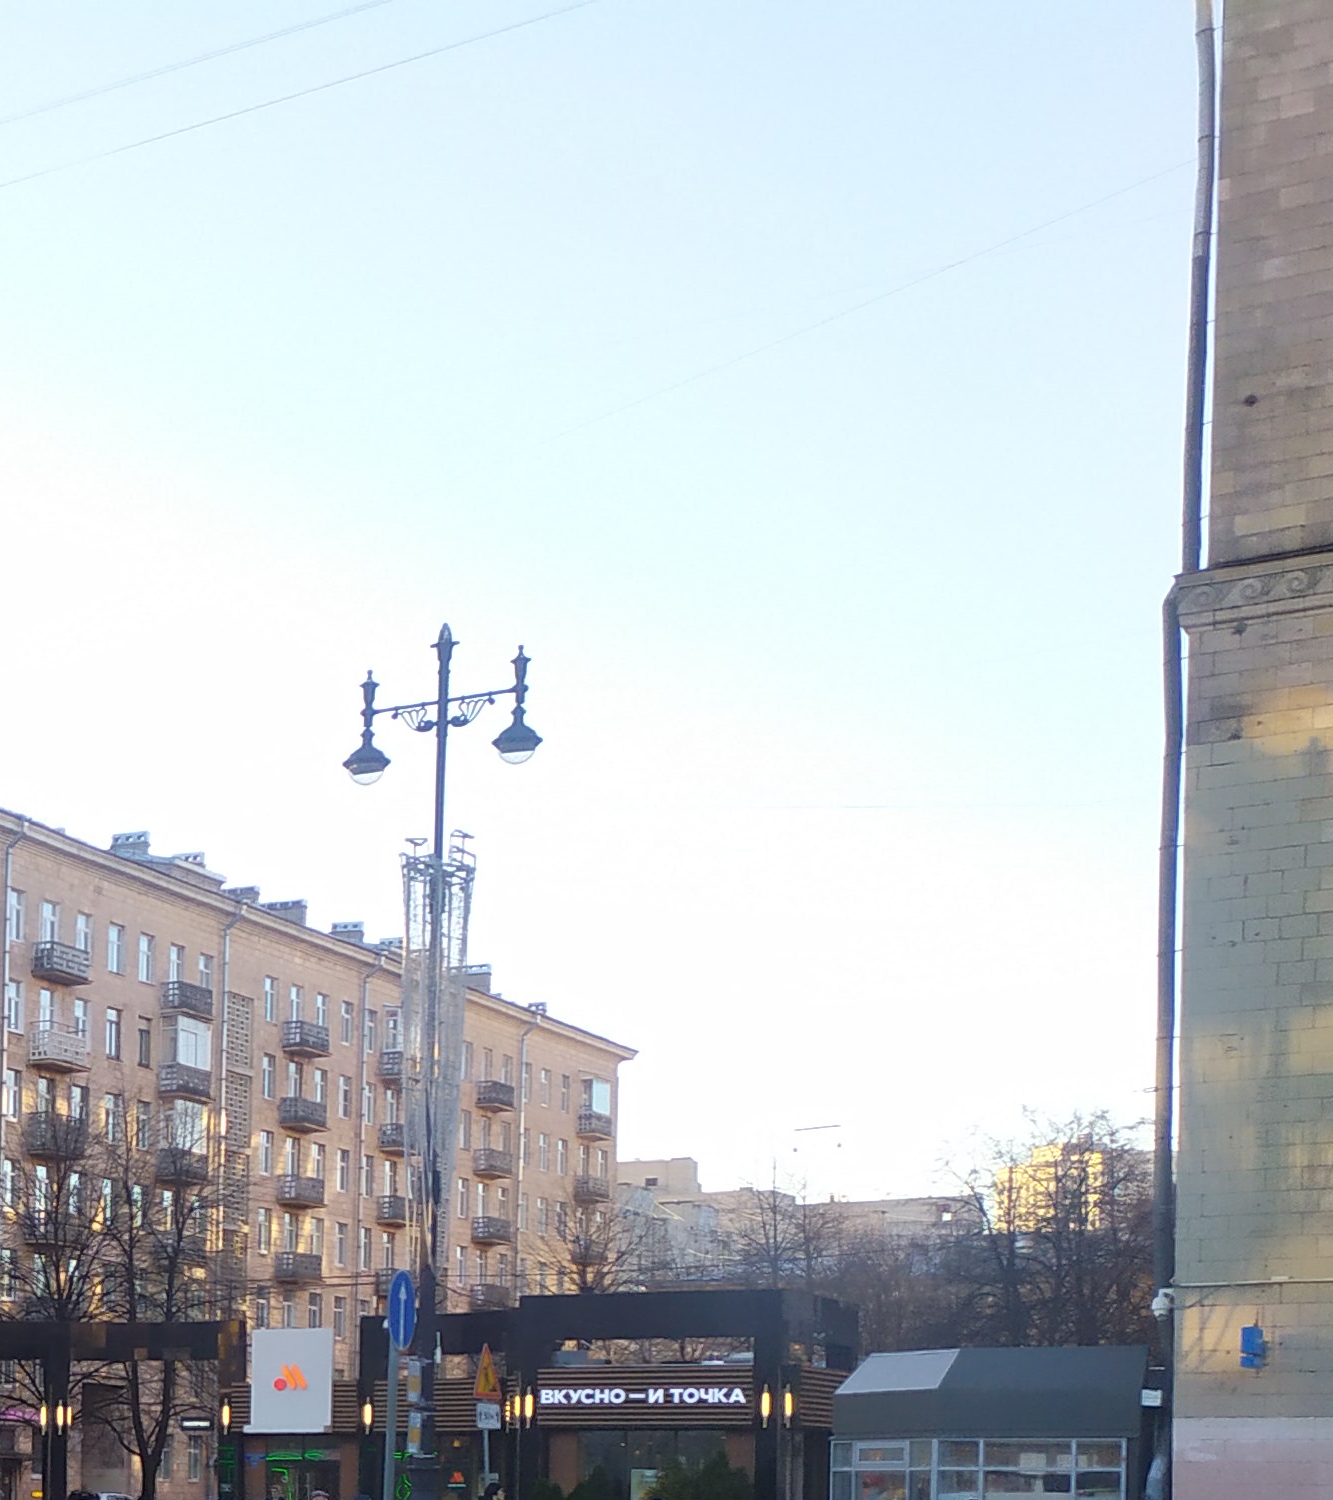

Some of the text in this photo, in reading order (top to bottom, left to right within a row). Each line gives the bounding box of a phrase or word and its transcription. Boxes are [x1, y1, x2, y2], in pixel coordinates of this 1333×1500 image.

[540, 1388, 626, 1405] ВКУСНО
[648, 1388, 665, 1404] И
[669, 1387, 747, 1404] ТОЧКА
